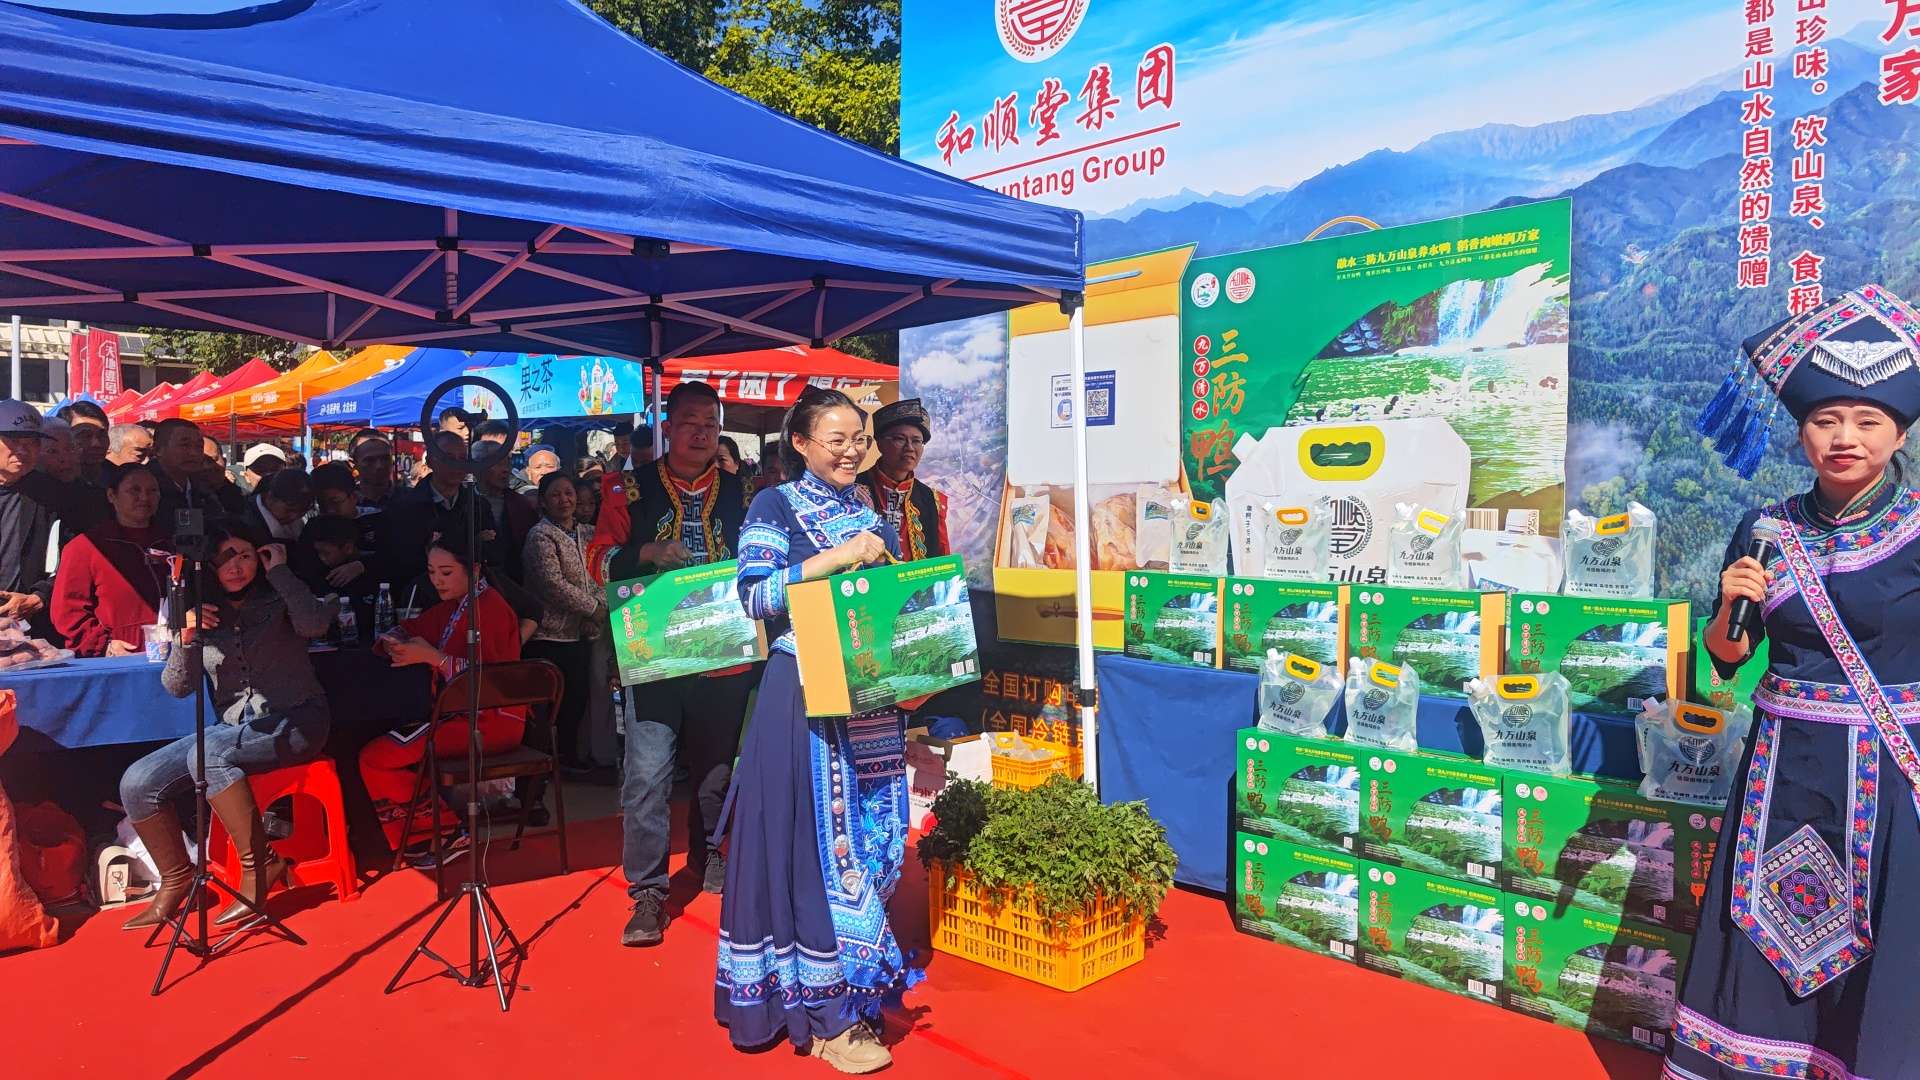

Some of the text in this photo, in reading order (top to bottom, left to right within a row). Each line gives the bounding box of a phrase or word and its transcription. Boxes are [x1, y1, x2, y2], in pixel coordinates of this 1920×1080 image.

[937, 45, 1175, 167] 和顺堂集团
[1083, 147, 1165, 183] Group
[1738, 0, 1774, 288] 都是山水自然的馈赠
[520, 359, 553, 403] 果之茶
[1495, 730, 1537, 742] 九万山泉
